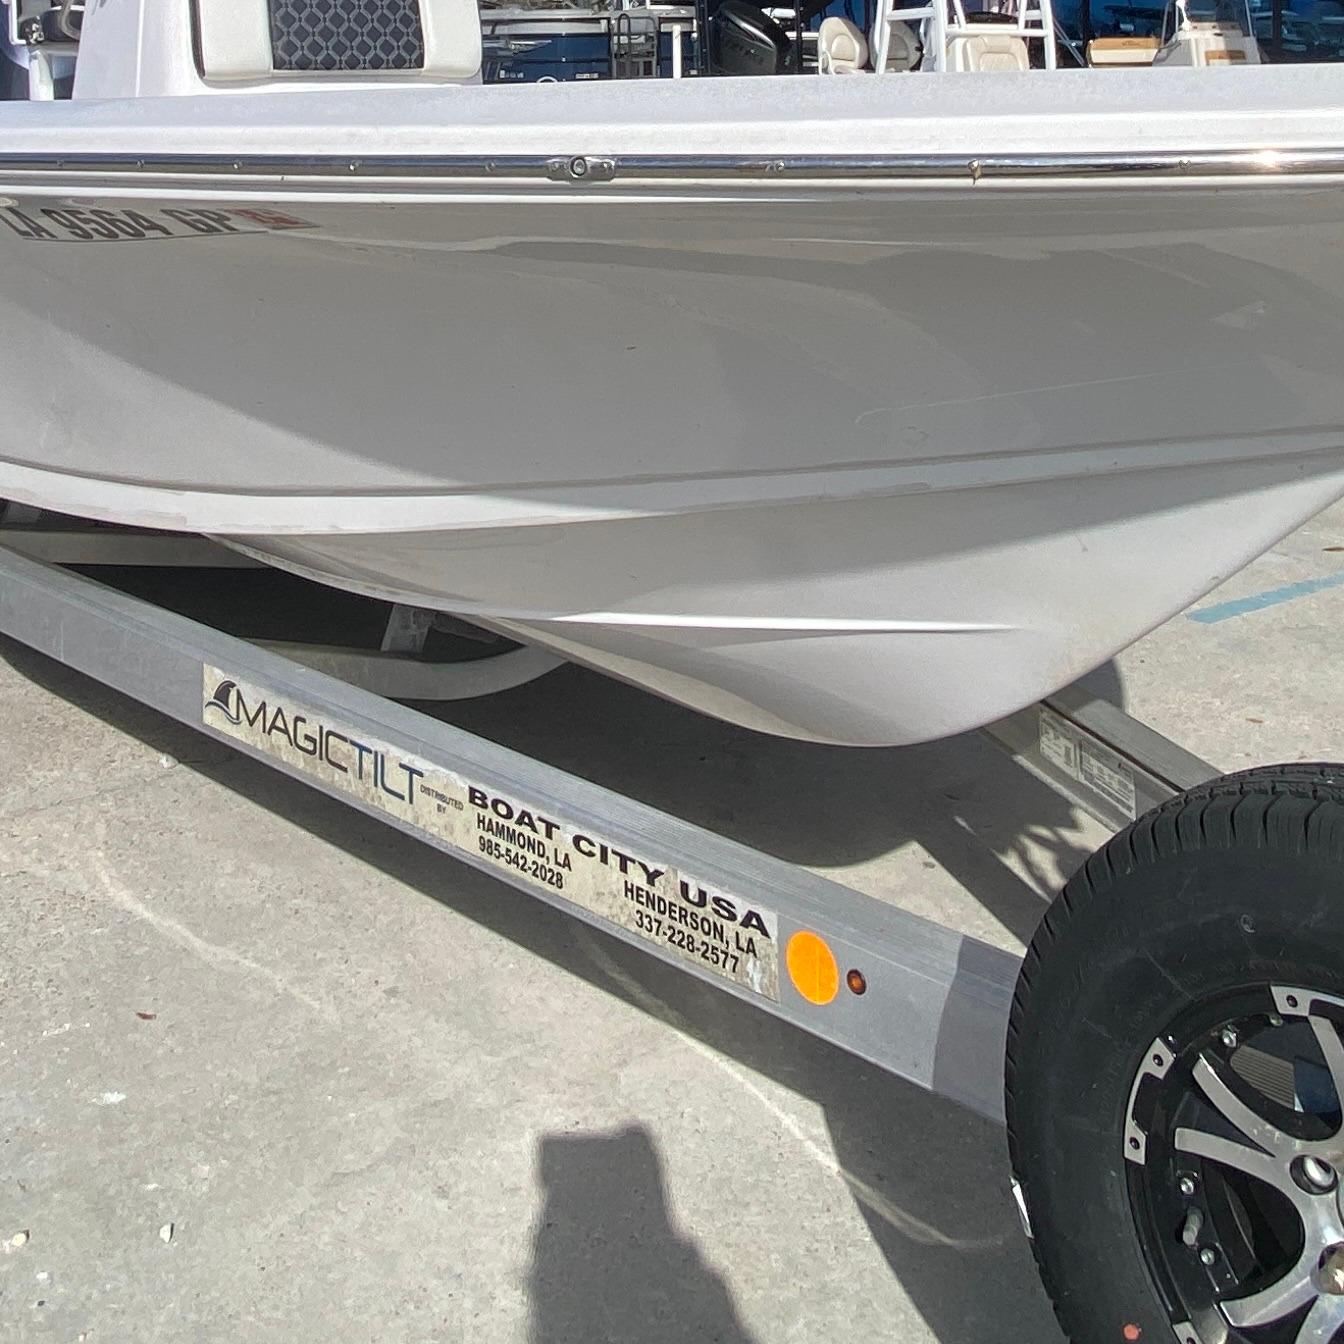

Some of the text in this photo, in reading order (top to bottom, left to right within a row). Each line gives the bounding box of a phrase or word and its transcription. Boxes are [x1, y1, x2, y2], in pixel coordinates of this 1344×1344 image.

[40, 208, 172, 240] 9564
[419, 784, 465, 811] DISTRIBUTED
[437, 804, 447, 814] BY
[468, 785, 770, 938] BOAT CITY USA
[477, 812, 572, 872] HAMMOND, LA
[478, 836, 564, 890] 985-542-2028
[624, 880, 758, 959] HENDERSON, LA
[635, 910, 740, 973] 337-228-2577
